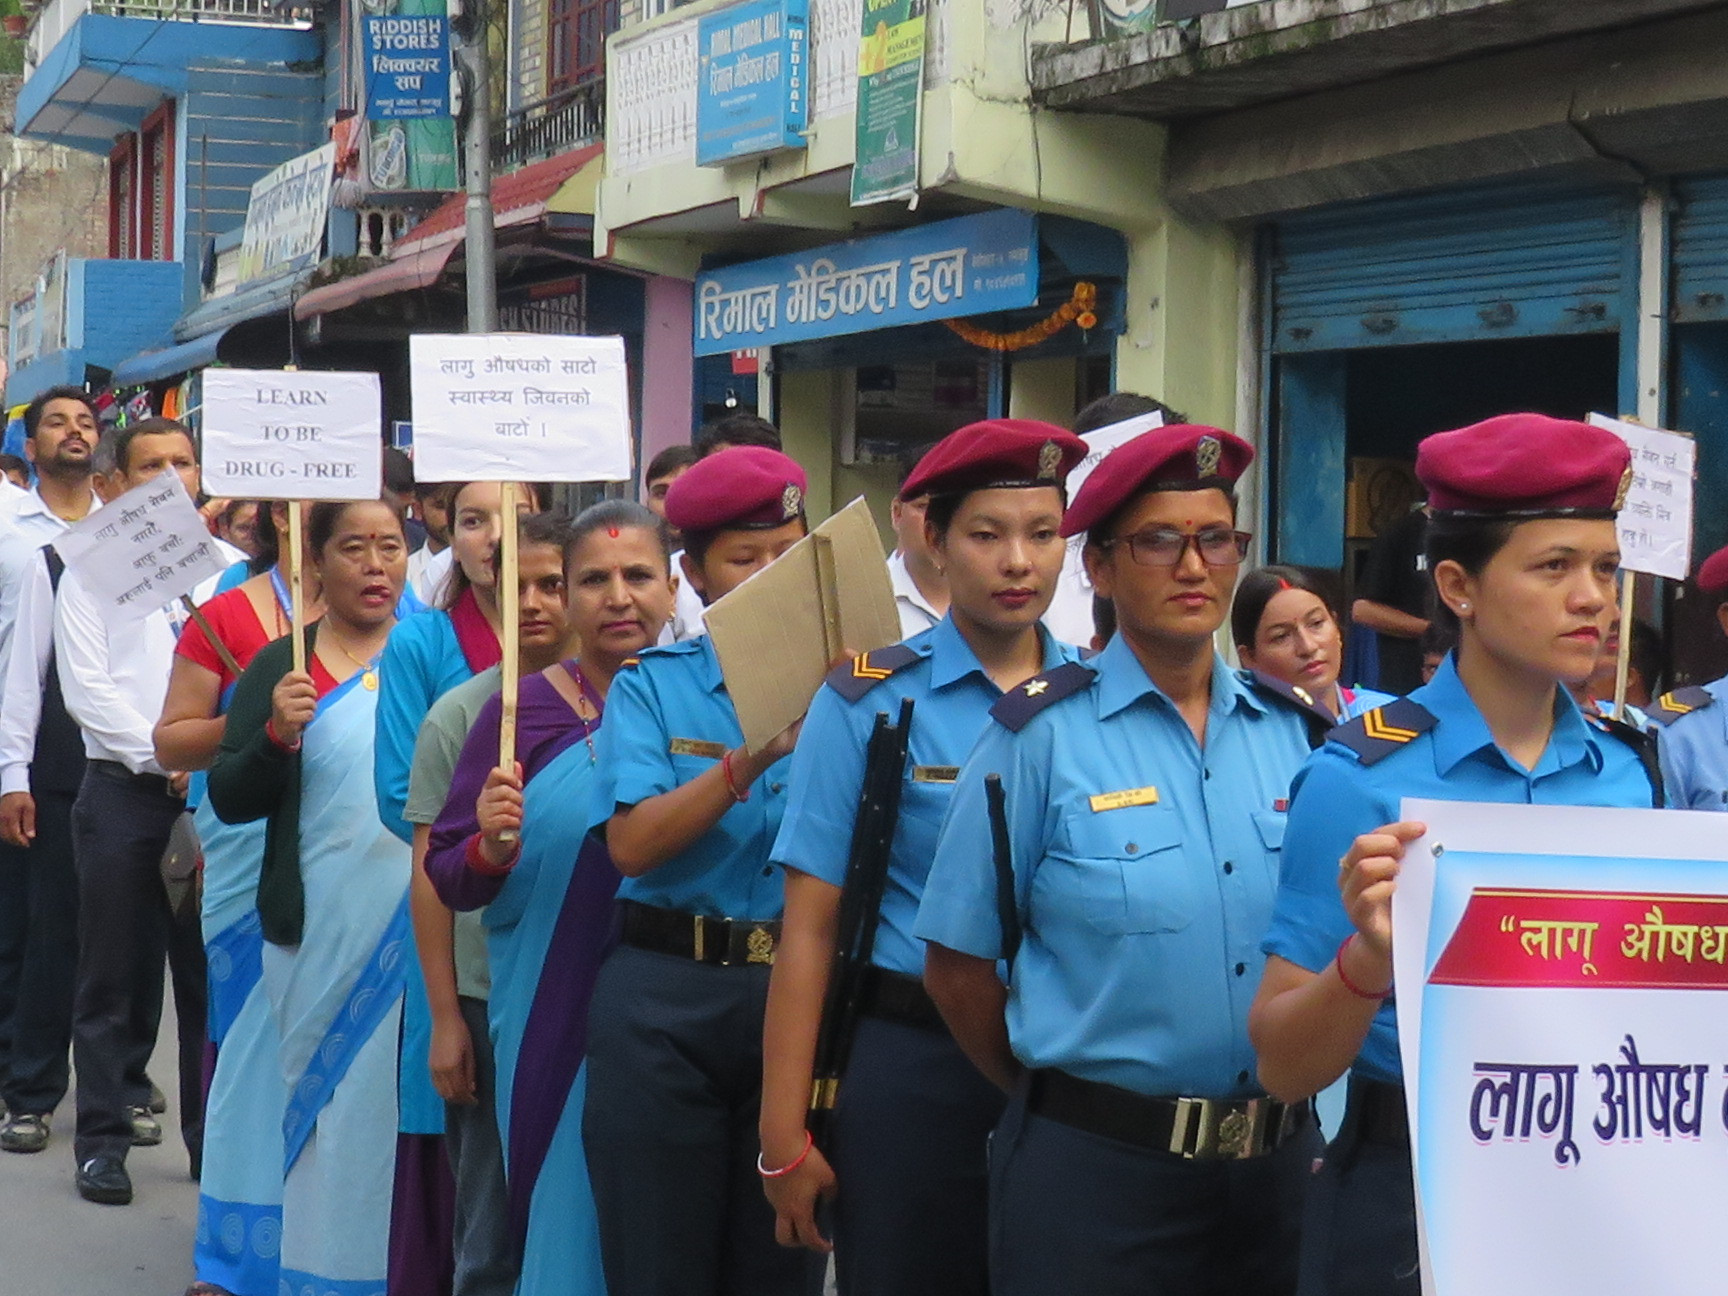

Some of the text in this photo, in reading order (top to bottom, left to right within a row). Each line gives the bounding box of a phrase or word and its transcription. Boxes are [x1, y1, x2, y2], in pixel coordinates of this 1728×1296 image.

[369, 19, 441, 34] RIDDISH
[373, 35, 439, 50] STORES
[788, 29, 803, 113] MEDICAL
[699, 281, 780, 340] रिमाल
[786, 258, 900, 324] मेडिकल
[908, 248, 968, 310] हल
[441, 354, 598, 377] लागु औषधको साटो
[256, 389, 328, 405] LEARN
[448, 386, 591, 406] स्वास्थ्य जिवनको
[261, 425, 322, 442] TO BE
[225, 460, 285, 478] DRUG
[303, 463, 357, 480] FREE
[119, 505, 149, 526] औषध
[149, 488, 176, 508] सेवन
[155, 565, 175, 583] पनि
[1471, 1061, 1582, 1167] लागू
[1592, 1033, 1710, 1142] औषध
